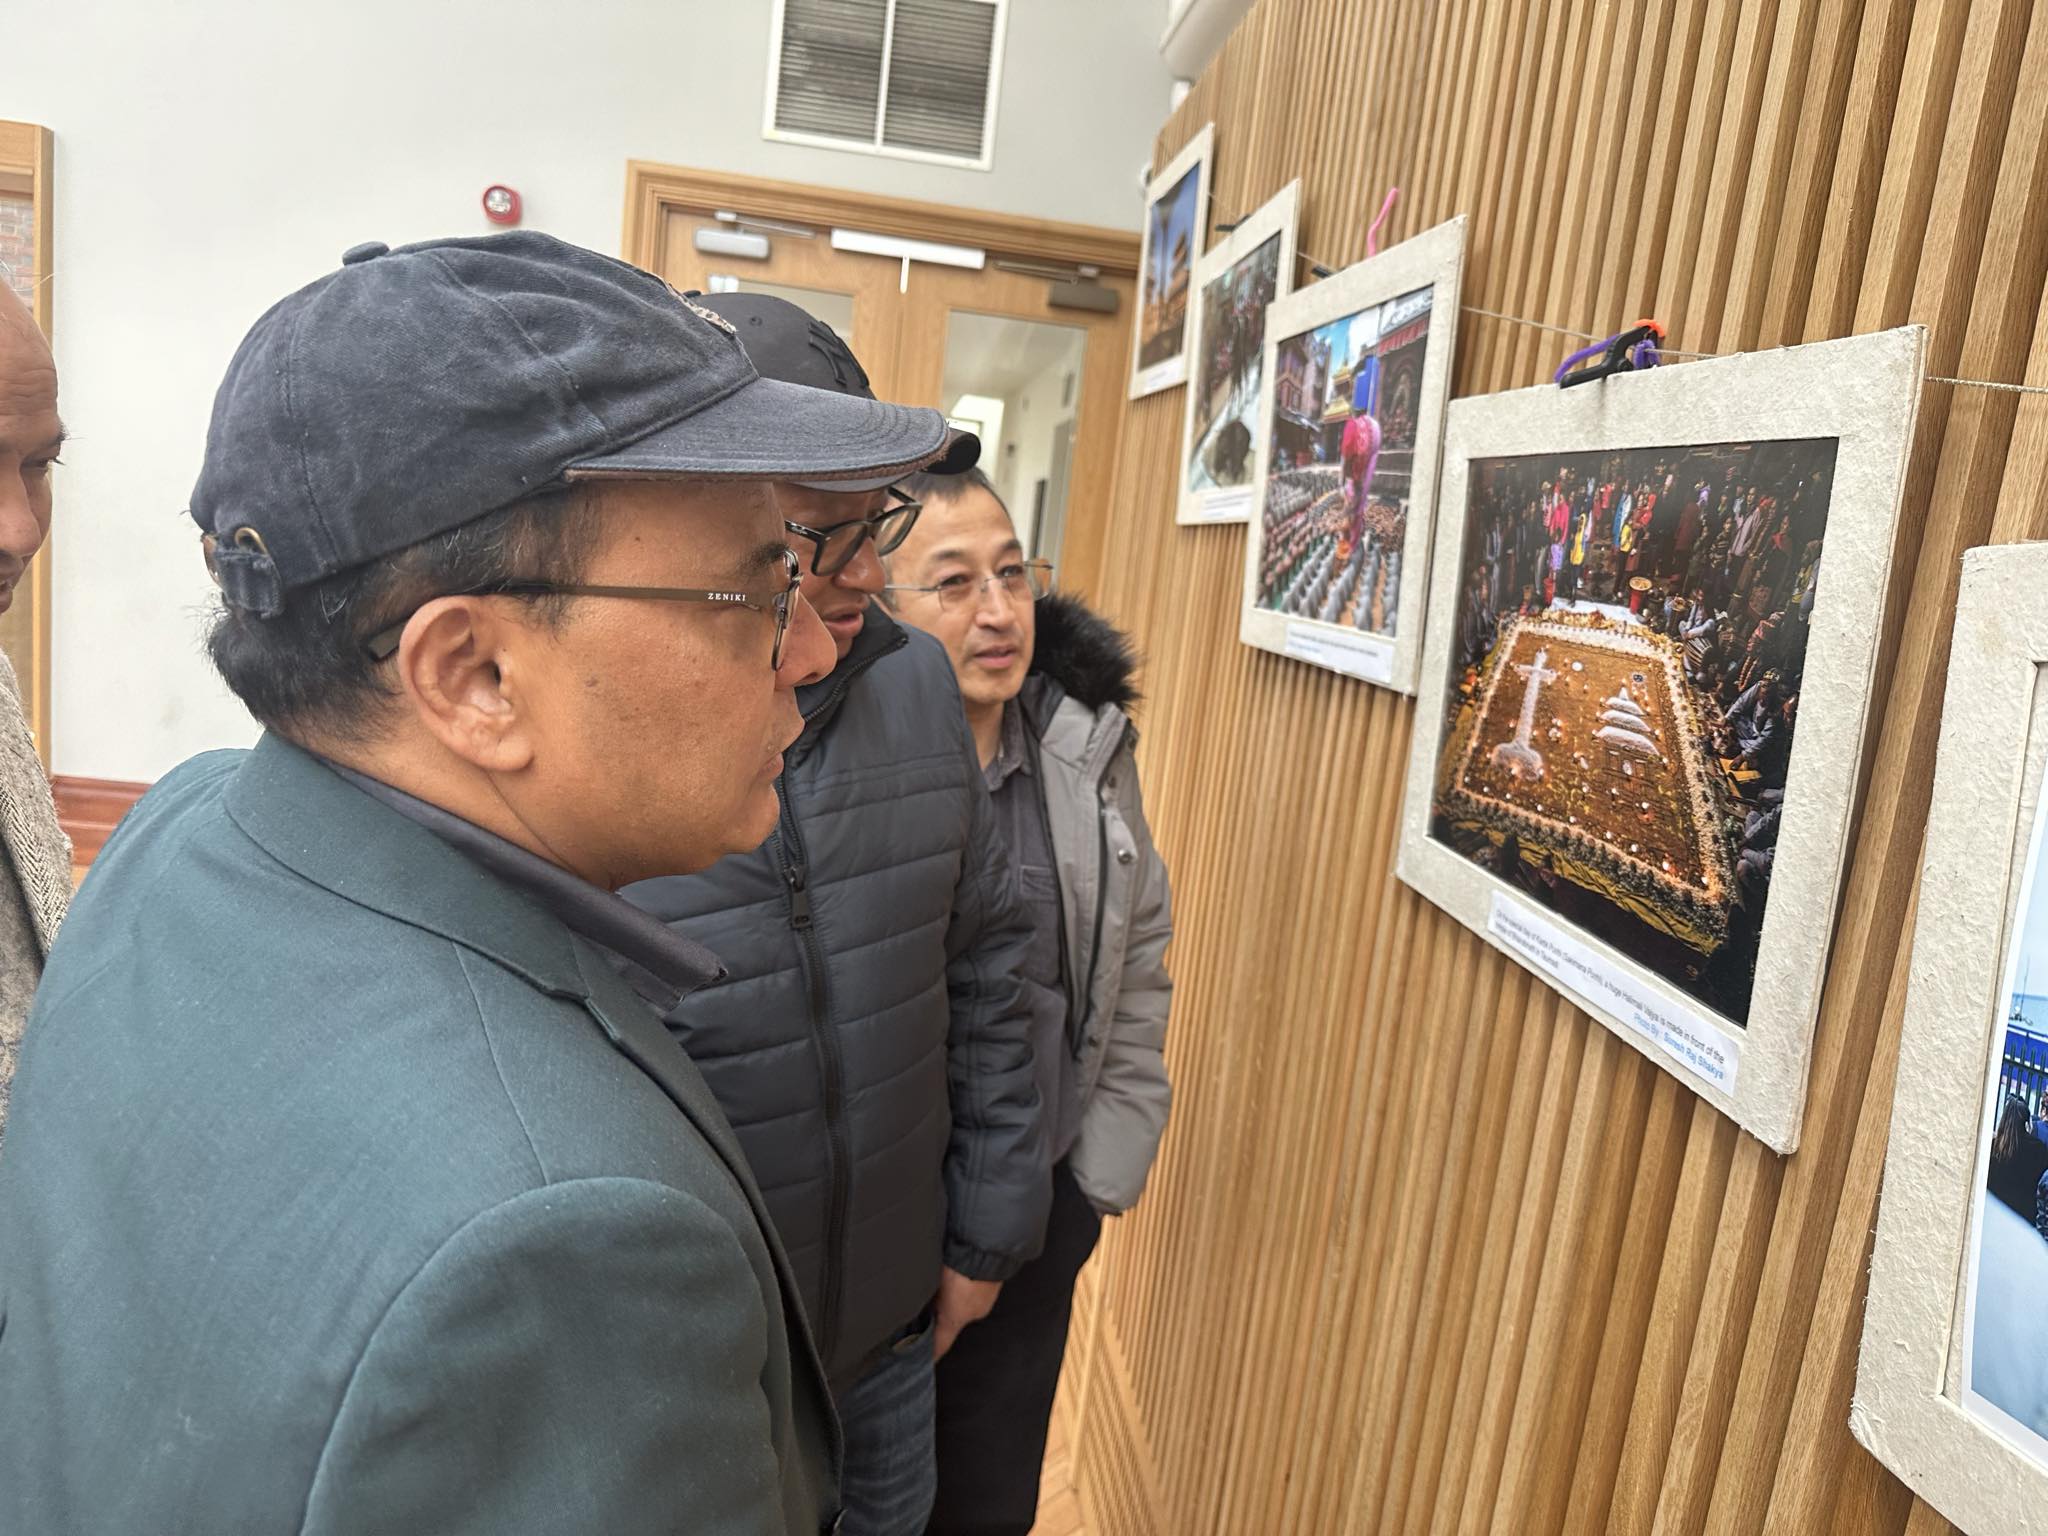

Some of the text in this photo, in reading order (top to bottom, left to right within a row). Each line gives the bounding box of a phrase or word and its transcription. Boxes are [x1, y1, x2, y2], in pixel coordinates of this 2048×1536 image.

[707, 592, 746, 602] ZENIKI
[1665, 1019, 1683, 1036] made
[1690, 1034, 1705, 1051] front
[1713, 1049, 1724, 1064] the
[1685, 1047, 1697, 1063] Raj
[1697, 1055, 1724, 1081] Shakya
